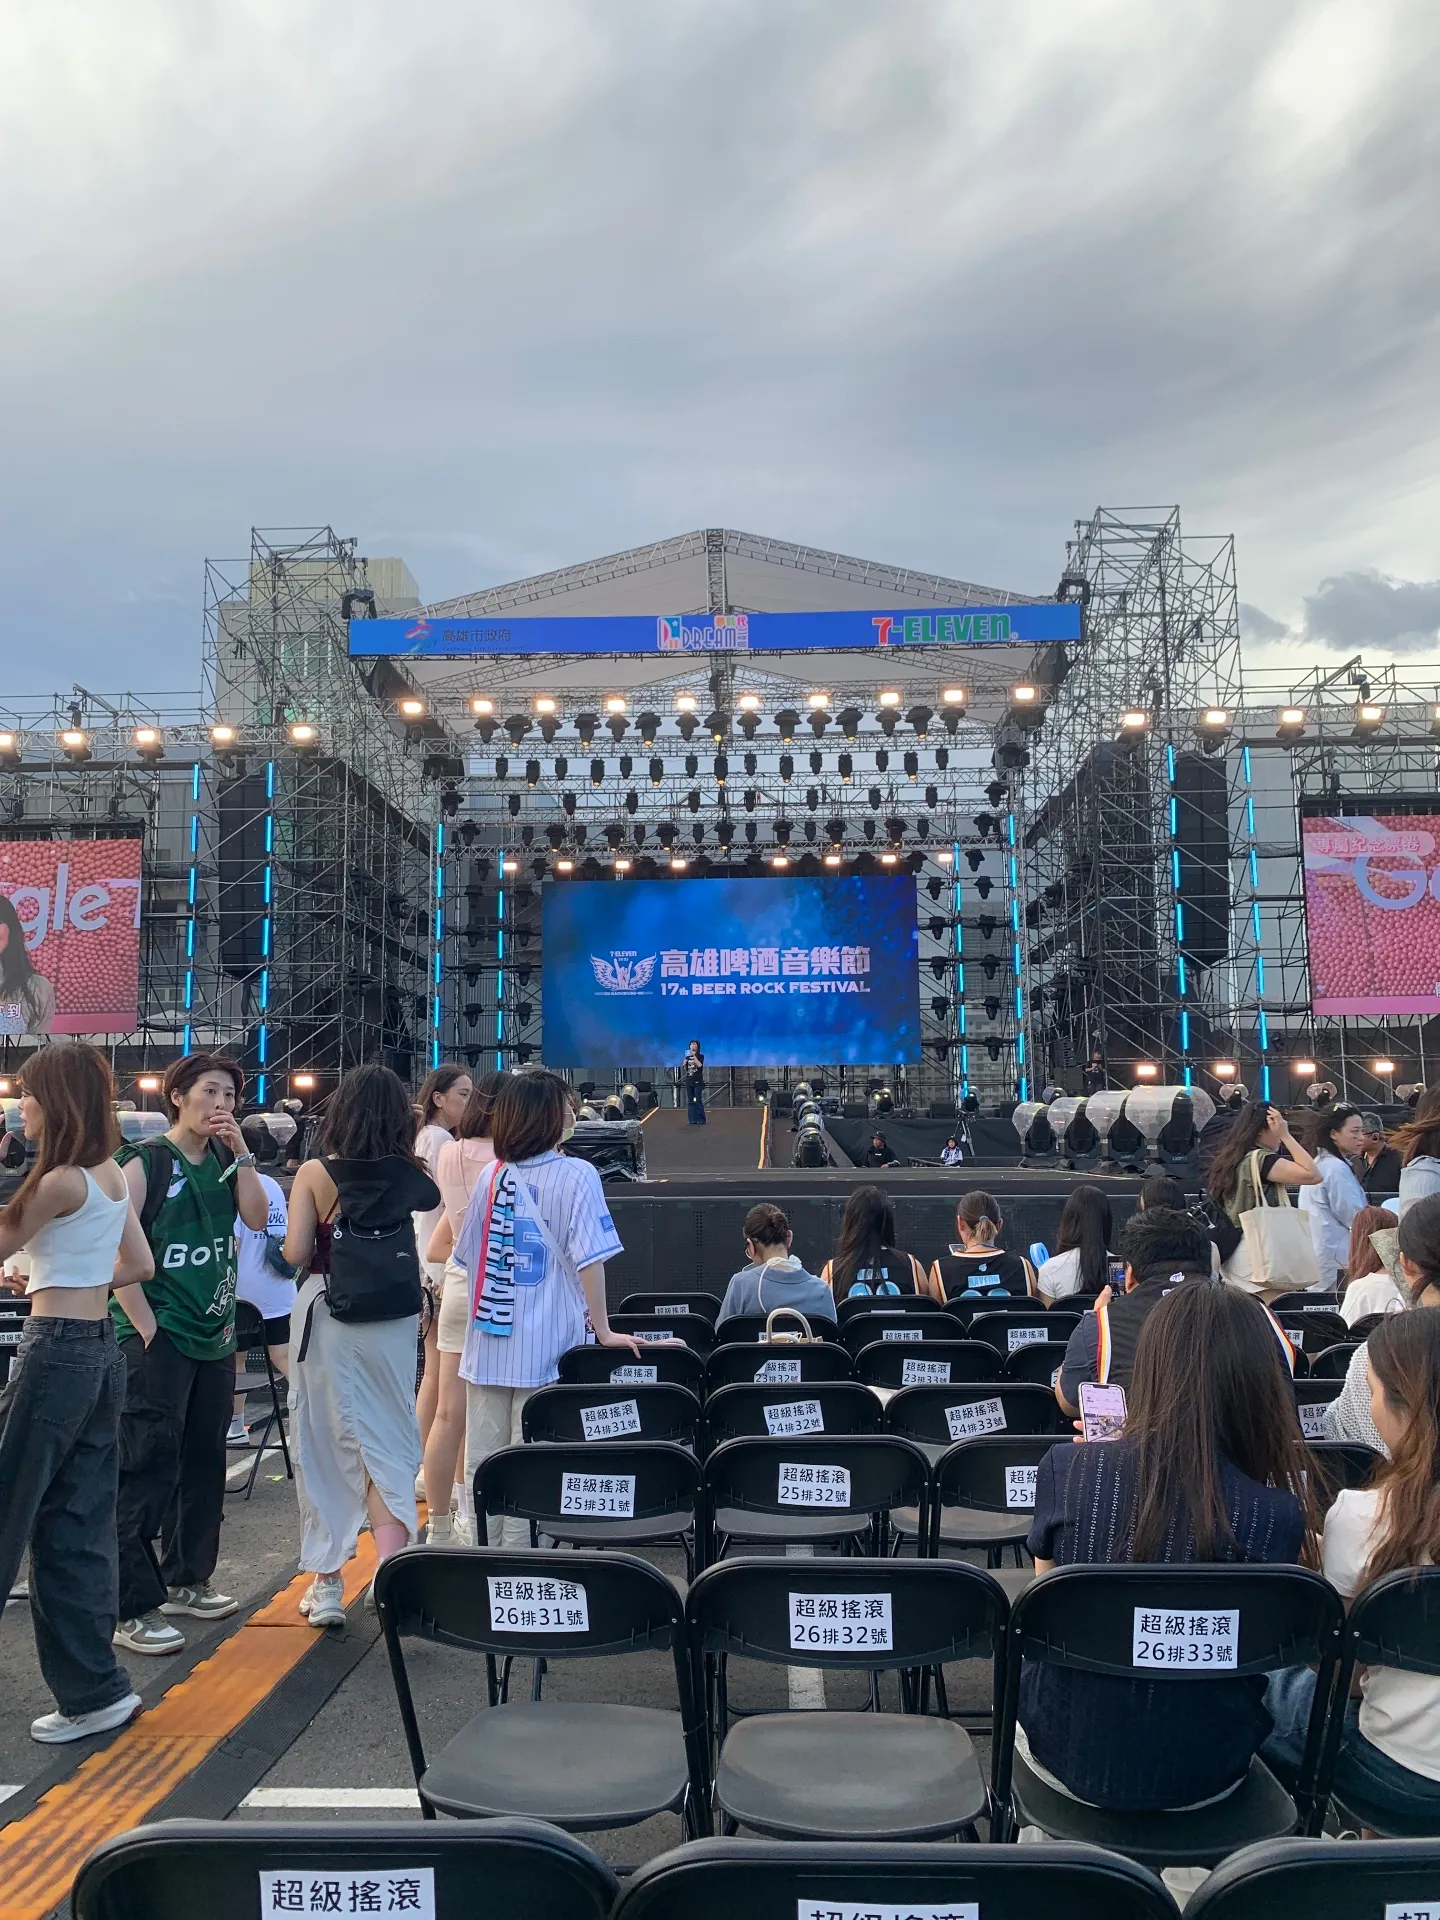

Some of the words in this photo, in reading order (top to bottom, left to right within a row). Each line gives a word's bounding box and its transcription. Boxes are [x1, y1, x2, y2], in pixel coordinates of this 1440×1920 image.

[442, 629, 512, 643] 高雄市政府
[682, 627, 736, 648] DREAM
[660, 945, 870, 978] 高雄啤酒音樂節
[660, 981, 689, 996] 17th
[692, 982, 737, 995] BEER
[740, 981, 786, 995] ROCK
[788, 980, 870, 994] FESTIVAL
[885, 1332, 920, 1340] 超級搖滾
[1010, 1330, 1045, 1339] 超級搖滾
[613, 1367, 654, 1378] 超級搖滾
[765, 1362, 798, 1372] 級搖滾
[906, 1362, 948, 1374] 超級搖滾
[585, 1403, 634, 1422] 超級搖滾
[768, 1402, 818, 1420] 超級搖滾
[949, 1401, 1000, 1421] 超級搖滾
[585, 1418, 639, 1437] 24排31號
[769, 1418, 821, 1435] 24排32號
[950, 1416, 1005, 1434] 24排33號
[783, 1467, 846, 1484] 超級搖滾
[566, 1478, 630, 1493] 超級搖滾
[780, 1486, 848, 1503] 25排32號
[563, 1495, 631, 1512] 25排31號
[494, 1581, 580, 1602] 超級搖滾
[493, 1606, 584, 1627] 26排31號
[795, 1598, 885, 1620] 超級搖滾
[793, 1624, 888, 1645] 26排32號
[1140, 1614, 1232, 1637] 超級搖滾
[1137, 1641, 1233, 1663] 26排33號
[271, 1878, 422, 1914] 超級搖滾
